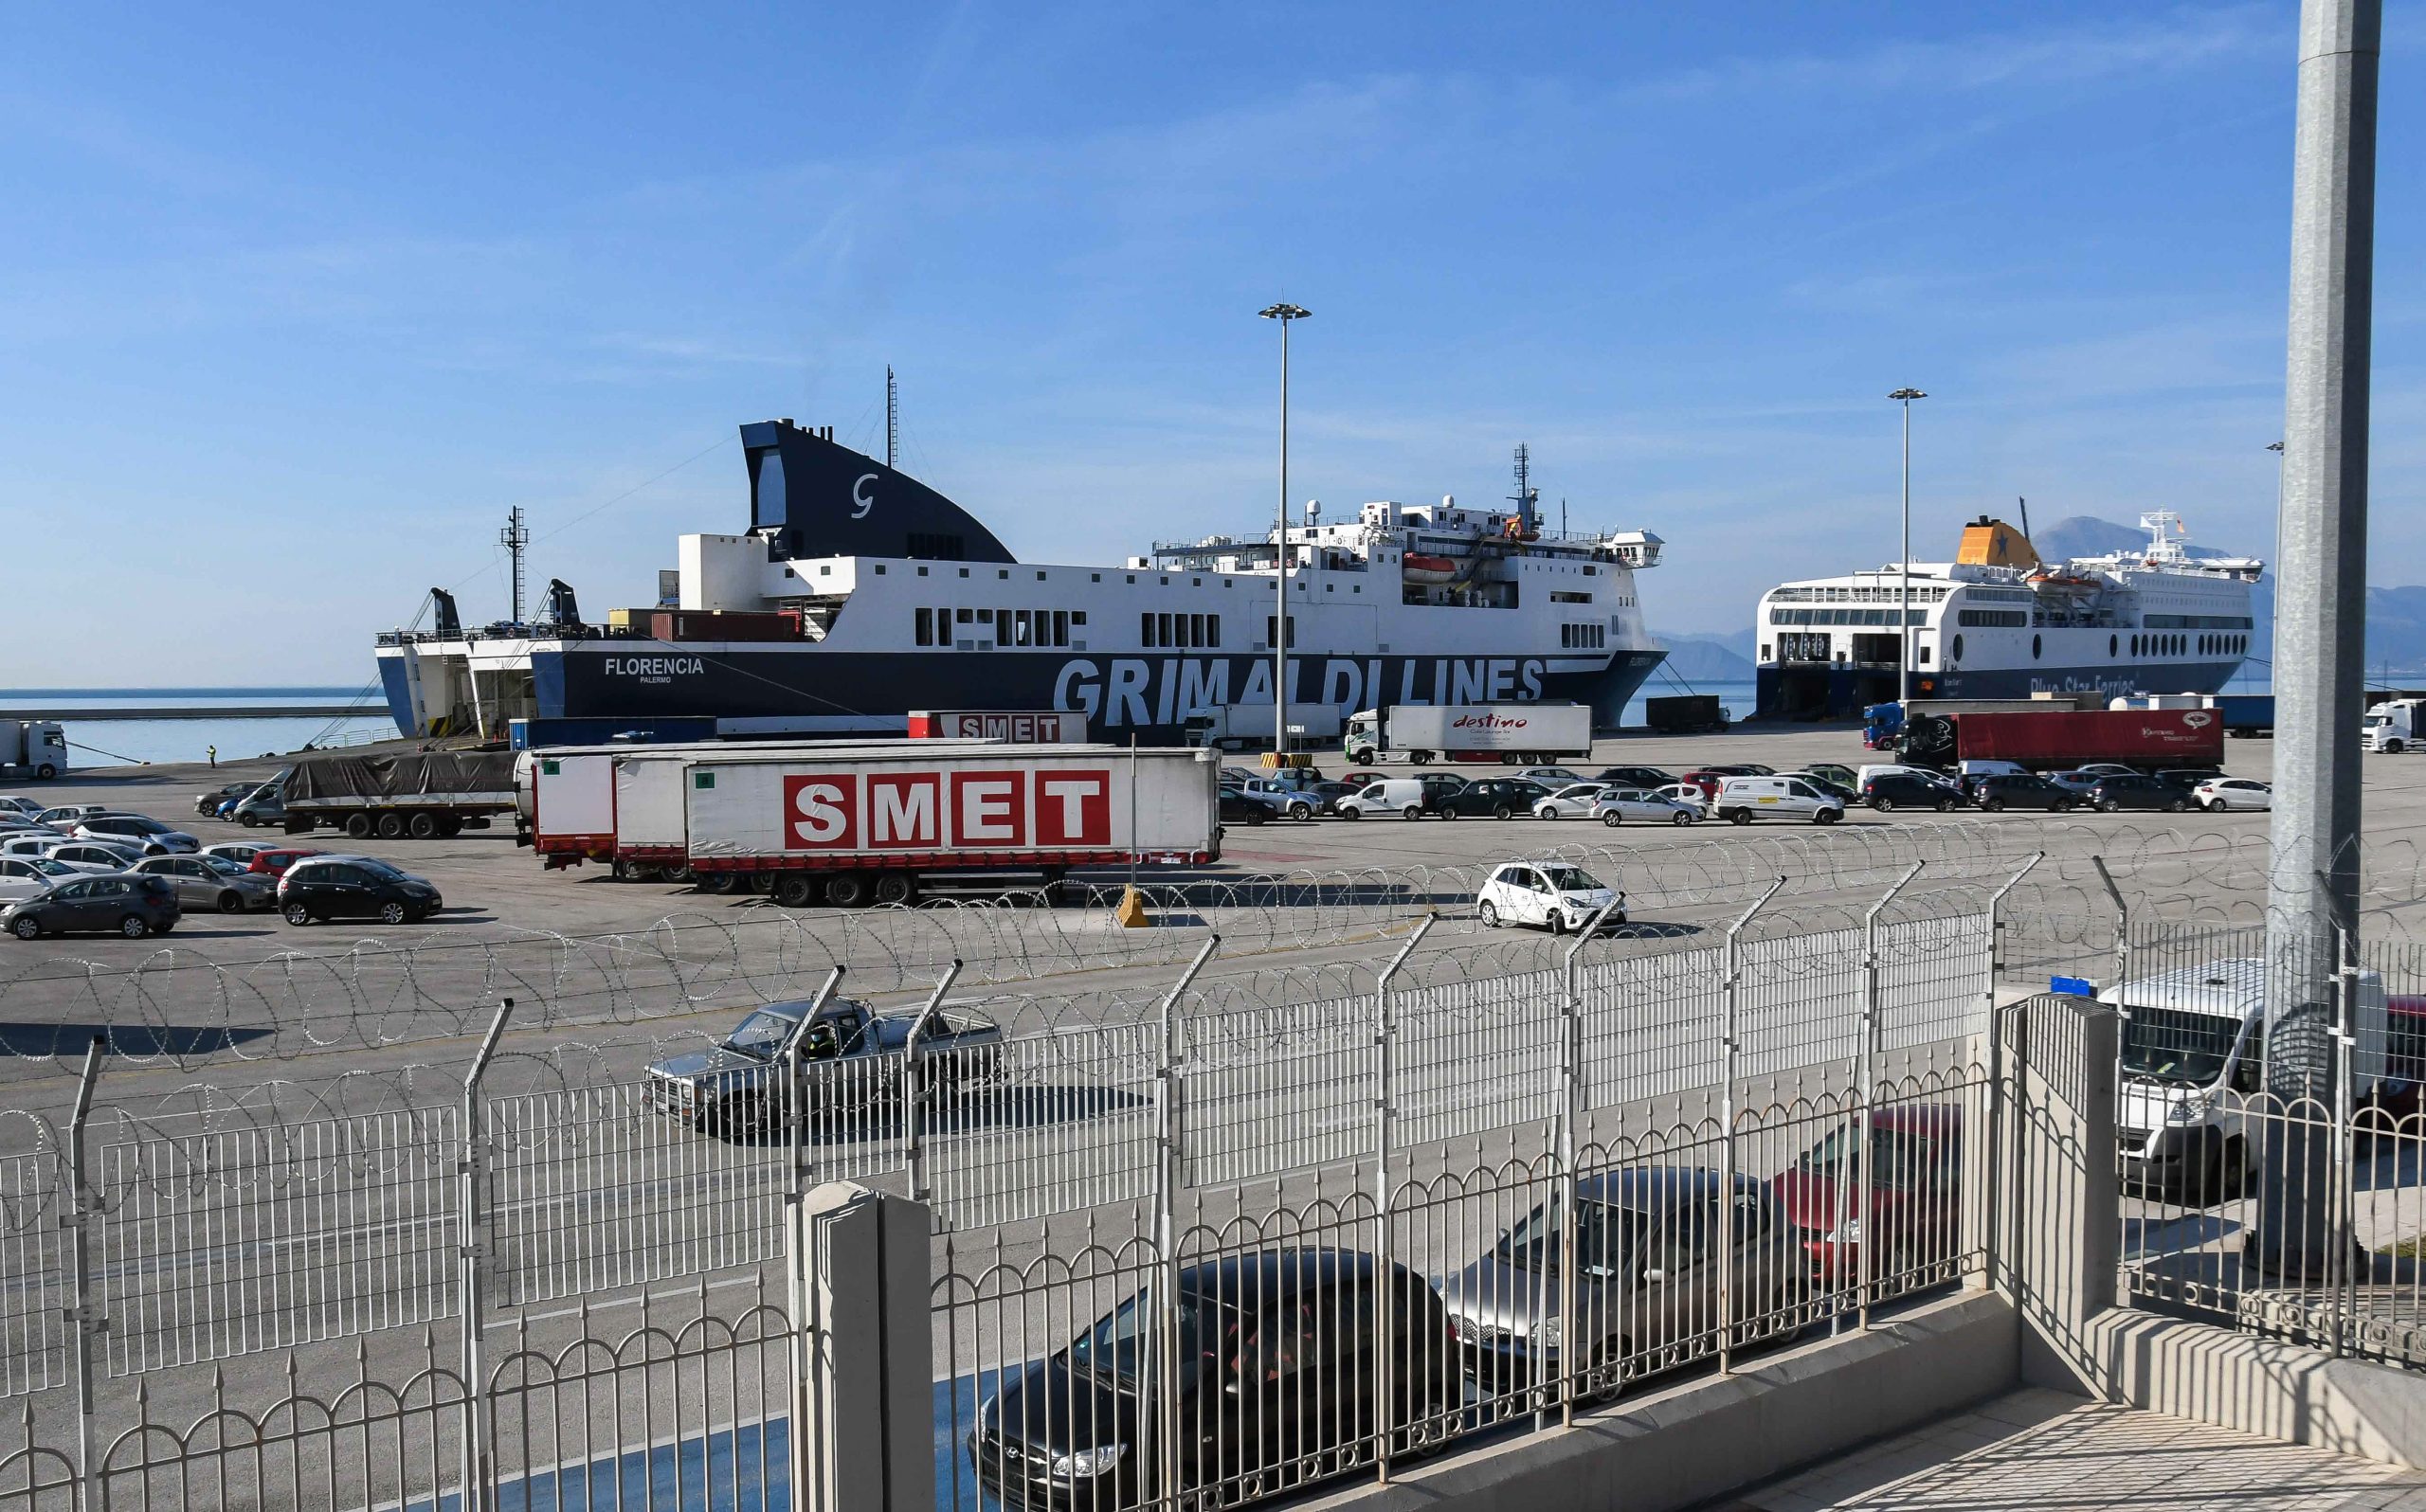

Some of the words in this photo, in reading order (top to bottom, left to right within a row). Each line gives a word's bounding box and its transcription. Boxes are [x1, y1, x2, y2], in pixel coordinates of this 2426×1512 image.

[605, 657, 704, 675] FLORENCIA
[1053, 658, 1383, 727] GRIMALDI
[1399, 658, 1545, 707] LINES
[962, 717, 1058, 742] SMET
[1452, 712, 1528, 729] destino
[793, 779, 1101, 842] SMET
